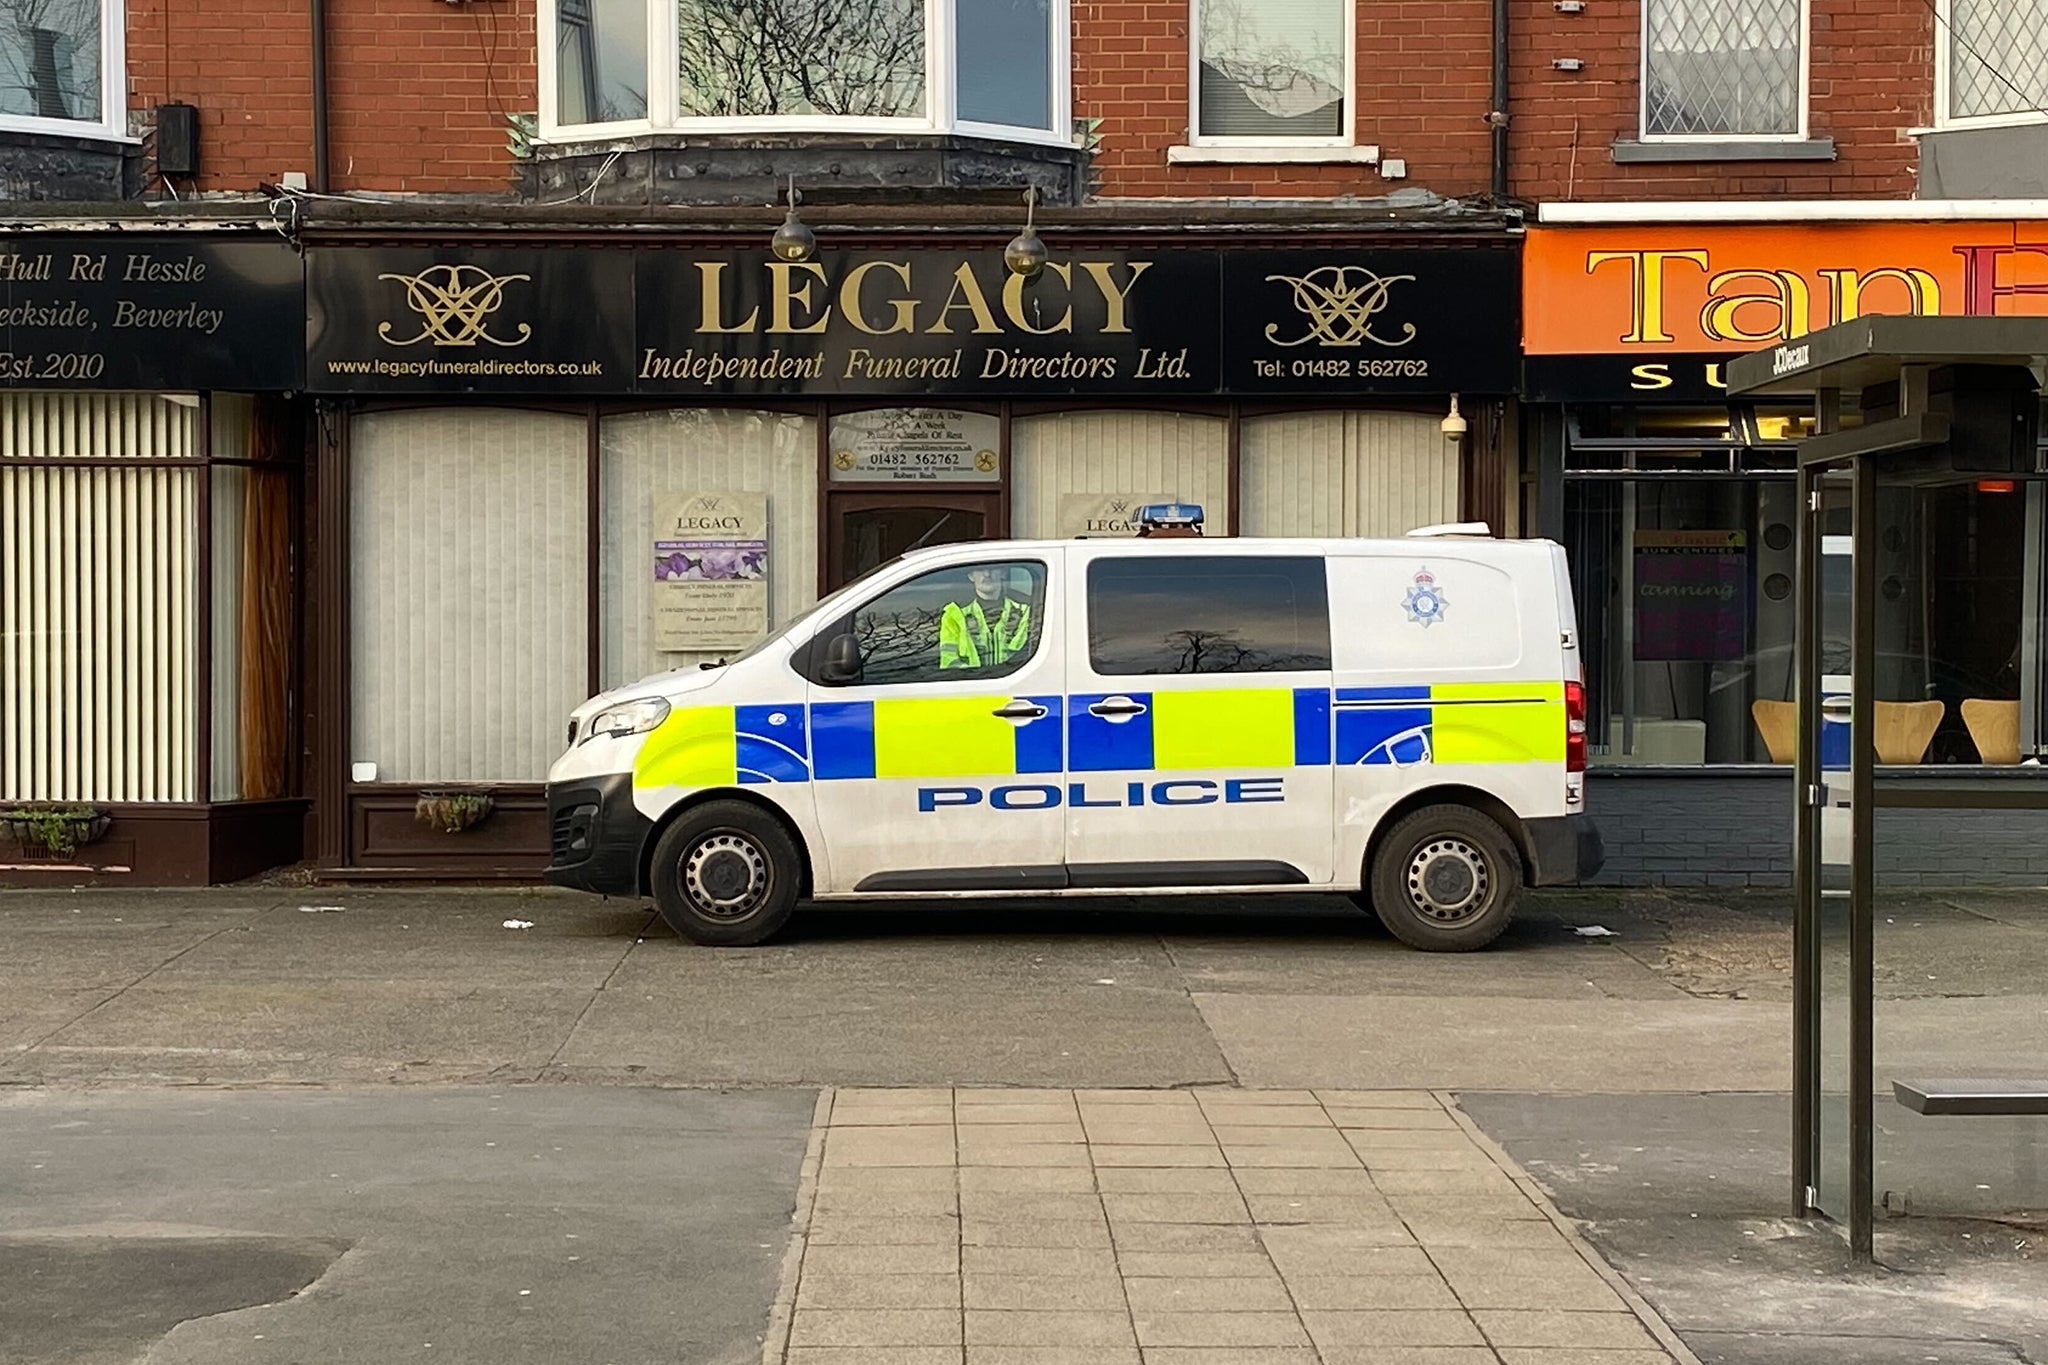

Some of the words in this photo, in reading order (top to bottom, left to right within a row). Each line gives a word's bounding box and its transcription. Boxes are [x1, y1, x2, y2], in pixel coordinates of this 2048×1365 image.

[0, 254, 52, 281] Hull
[68, 254, 108, 281] Rd
[122, 254, 206, 282] Hessle
[693, 260, 1154, 335] LEGACY
[112, 300, 223, 334] Beverley
[328, 359, 602, 378] www.legacyfuneraldirectors.co.uk
[638, 348, 825, 386] Independent
[843, 348, 961, 379] Funeral
[979, 347, 1117, 379] Directors
[1134, 348, 1192, 379] Ltd.
[1253, 360, 1286, 377] Tel:
[1292, 360, 1350, 377] 01482
[1357, 360, 1429, 377] 562762
[1773, 344, 1810, 376] JCDecaux
[870, 453, 907, 464] 01482
[915, 453, 960, 464] 562762
[677, 517, 744, 530] LEGACY
[1086, 519, 1141, 532] LEGA
[1640, 582, 1738, 600] tanning
[918, 777, 1285, 812] POLICE
